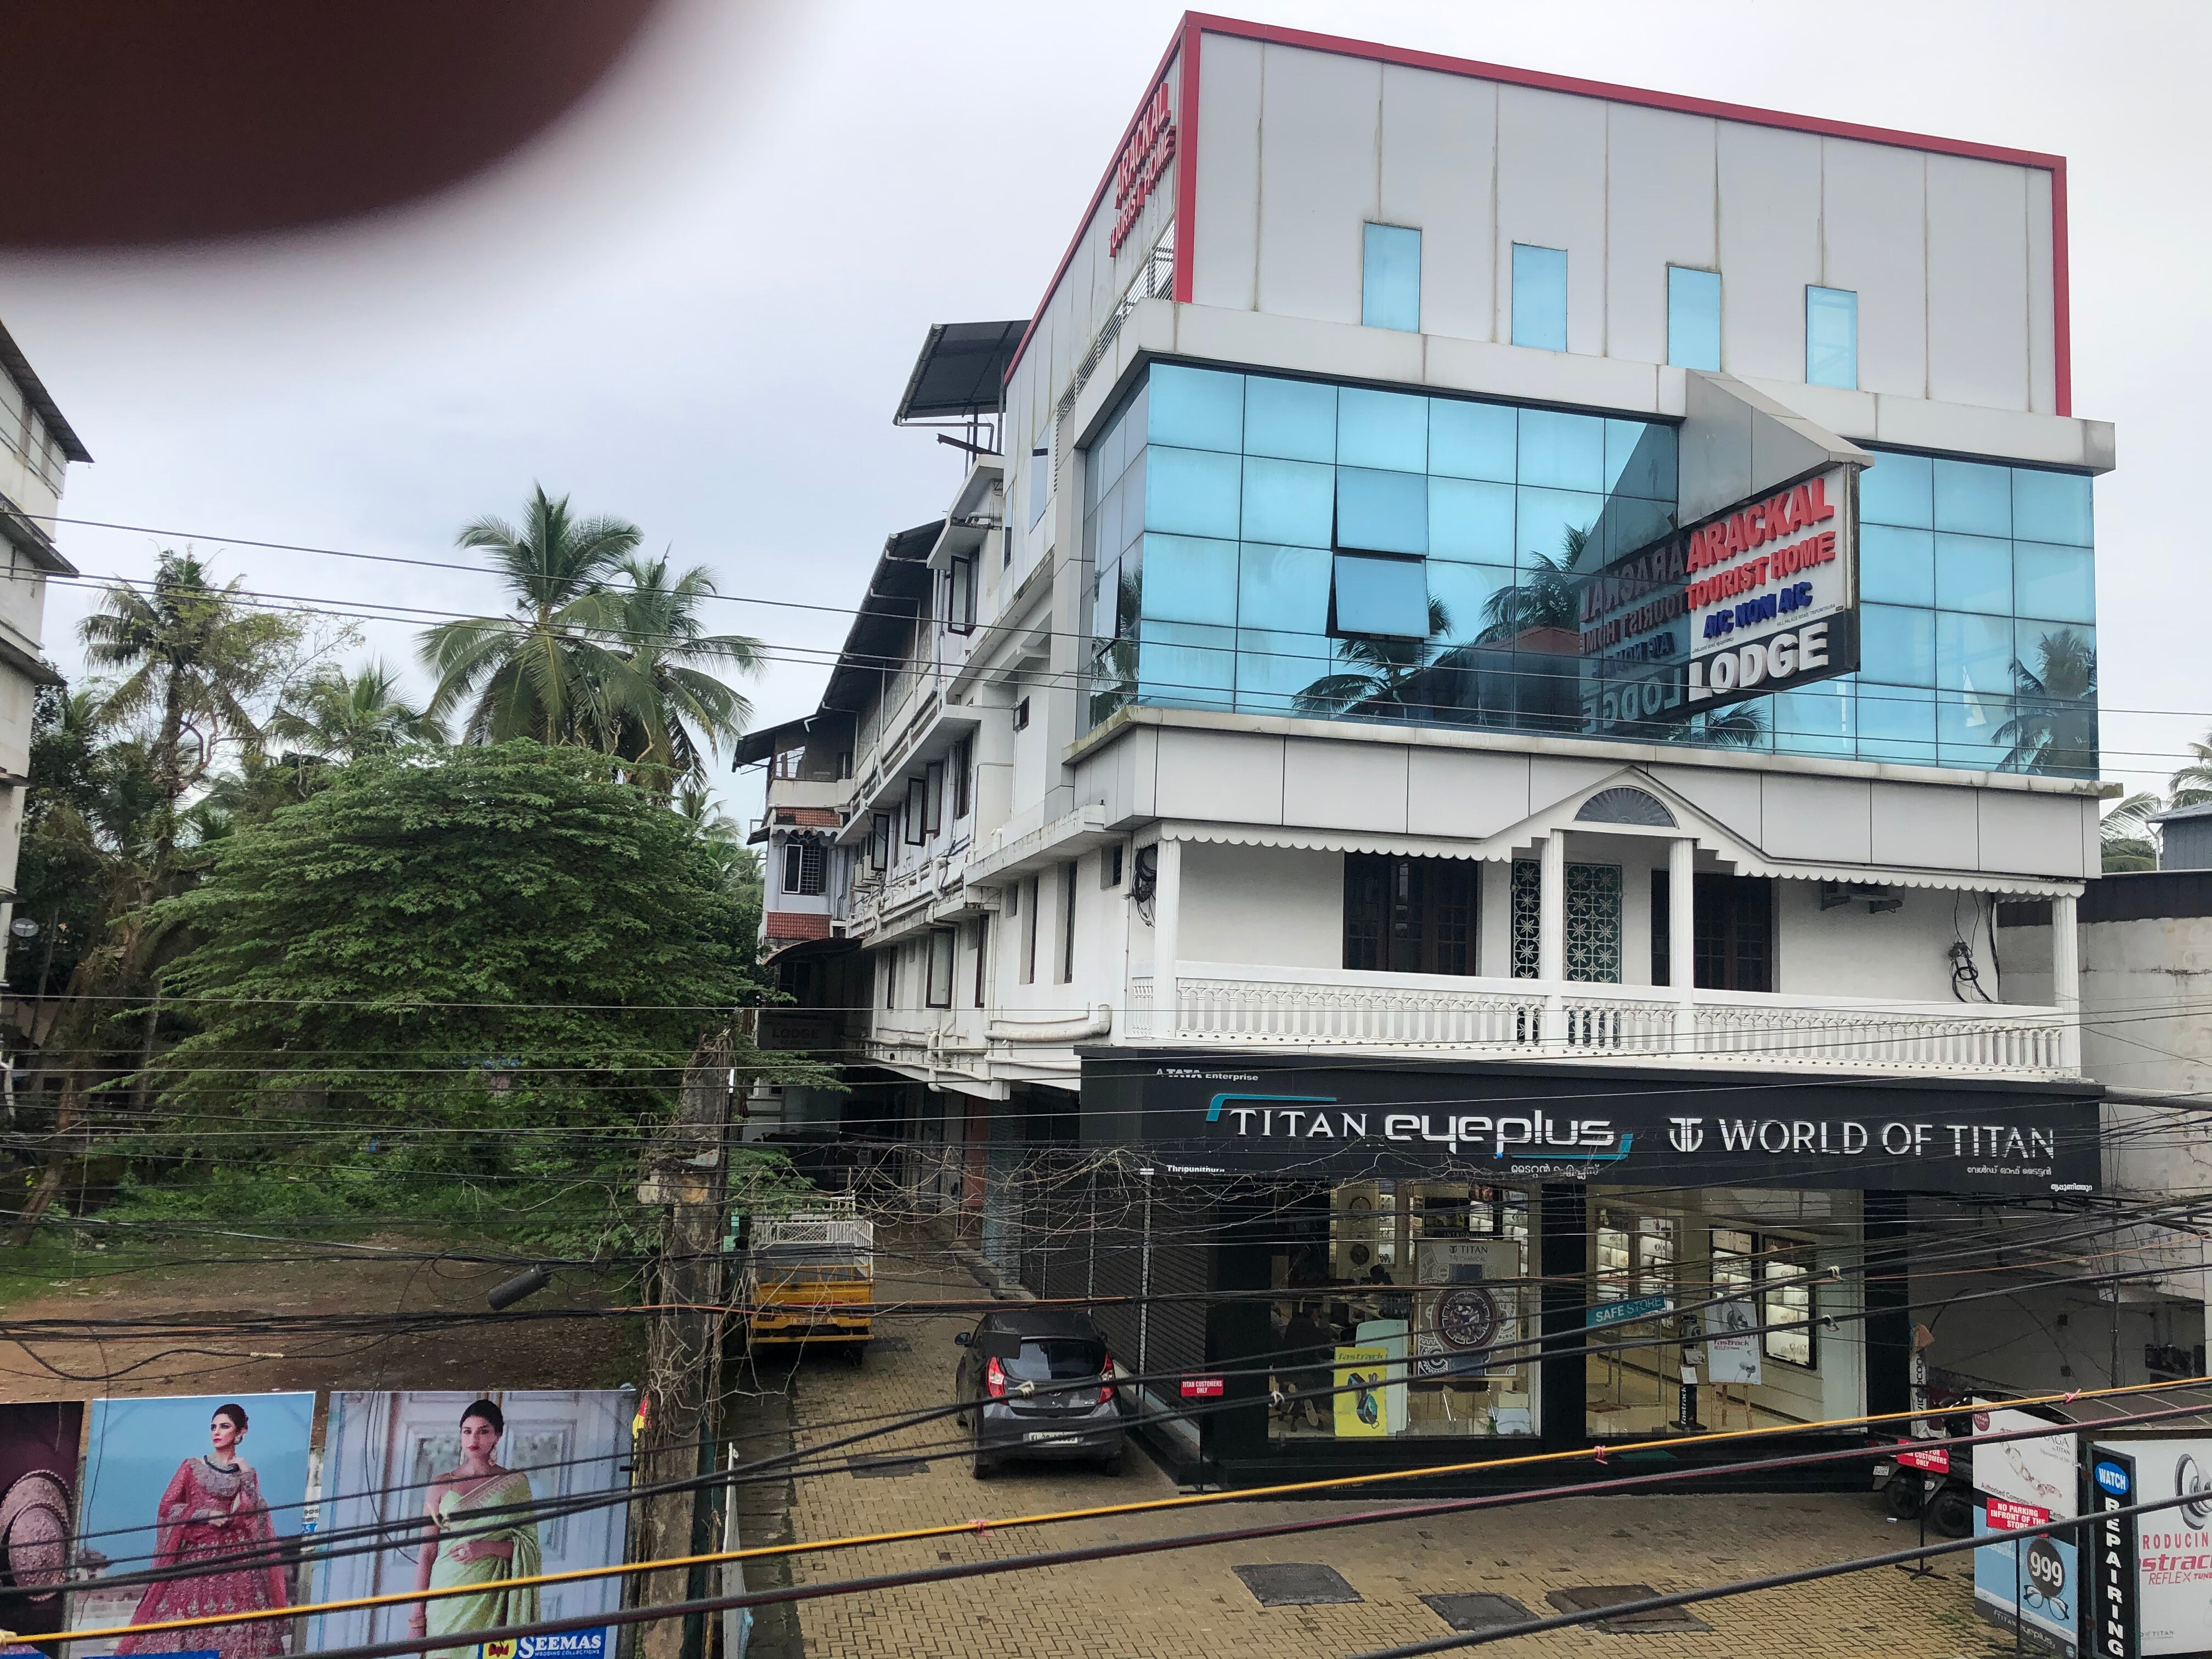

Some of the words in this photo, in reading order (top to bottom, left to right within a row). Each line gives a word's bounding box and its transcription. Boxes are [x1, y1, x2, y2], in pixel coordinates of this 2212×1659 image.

[1115, 82, 1171, 210] ARACKAL
[1109, 177, 1145, 258] TOURIST
[1144, 125, 1176, 195] HOME
[1686, 478, 1834, 573] ARACKAL
[1685, 556, 1770, 610] TOURIST
[1770, 531, 1836, 579] HOME
[1703, 609, 1734, 639] A/C
[1735, 594, 1776, 628] NON
[1778, 582, 1813, 614] A/C
[1689, 622, 1828, 702] LODGE
[1156, 1068, 1164, 1077] A
[1166, 1069, 1202, 1078] TATA
[1205, 1073, 1259, 1081] Enterprise
[1229, 1109, 1367, 1139] TITAN
[1385, 1110, 1615, 1154] eyeplus
[1719, 1119, 1867, 1155] WORLD
[1882, 1122, 1933, 1155] OF
[1943, 1125, 2055, 1160] TITAN
[1596, 1305, 1624, 1322] SAFE
[1627, 1296, 1662, 1314] STORE
[1915, 1452, 1947, 1465] CUSTOMERS
[2056, 1446, 2070, 1455] TITAN
[1916, 1459, 1929, 1467] ONLY
[1980, 1482, 2005, 1497] Authorised
[2098, 1468, 2126, 1491] WATCH
[1990, 1510, 2020, 1521] INFRONT
[2032, 1517, 2046, 1526] THE
[2009, 1504, 2039, 1517] PARKING
[2142, 1532, 2209, 1550] RODUCIN
[2030, 1551, 2062, 1587] 999
[2105, 1497, 2124, 1657] REPAIRING
[2149, 1571, 2191, 1585] REFLEX
[1996, 1613, 2016, 1627] TITAN
[518, 1635, 601, 1658] SEEMAS
